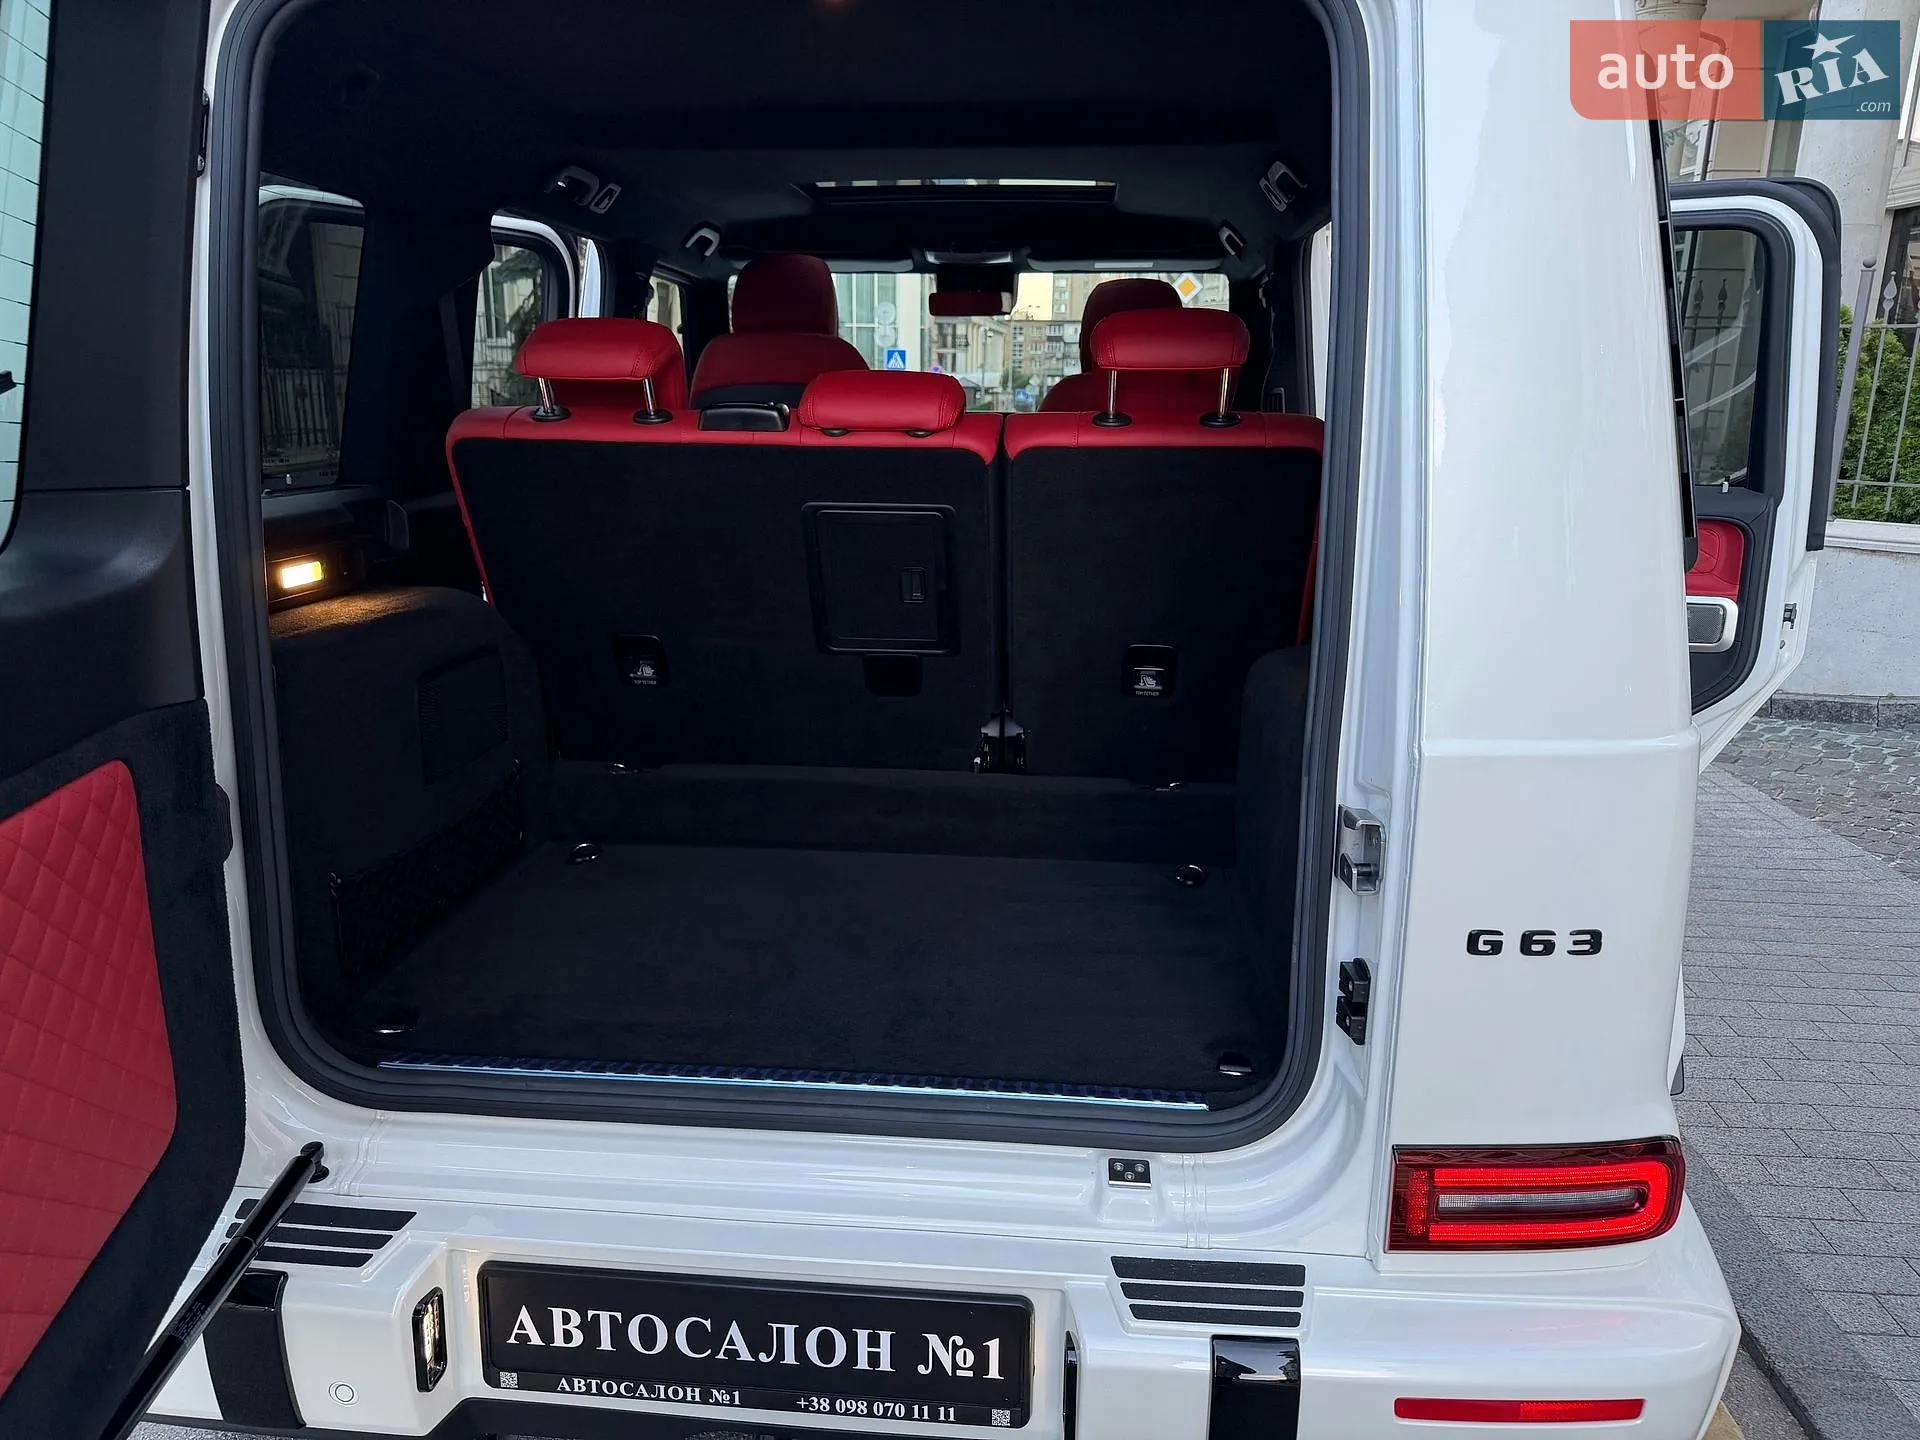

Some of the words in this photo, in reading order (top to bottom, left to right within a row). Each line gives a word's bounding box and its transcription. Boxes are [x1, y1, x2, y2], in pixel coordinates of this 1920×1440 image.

[506, 1304, 897, 1372] АВТОСАЛОН
[917, 1333, 1005, 1380] №1
[556, 1377, 701, 1402] АВТОСАЛОН
[708, 1389, 742, 1405] №1
[796, 1396, 831, 1412] +38
[835, 1399, 868, 1415] 098
[872, 1402, 906, 1418] 070
[911, 1404, 931, 1420] 11
[937, 1406, 957, 1422] 11
